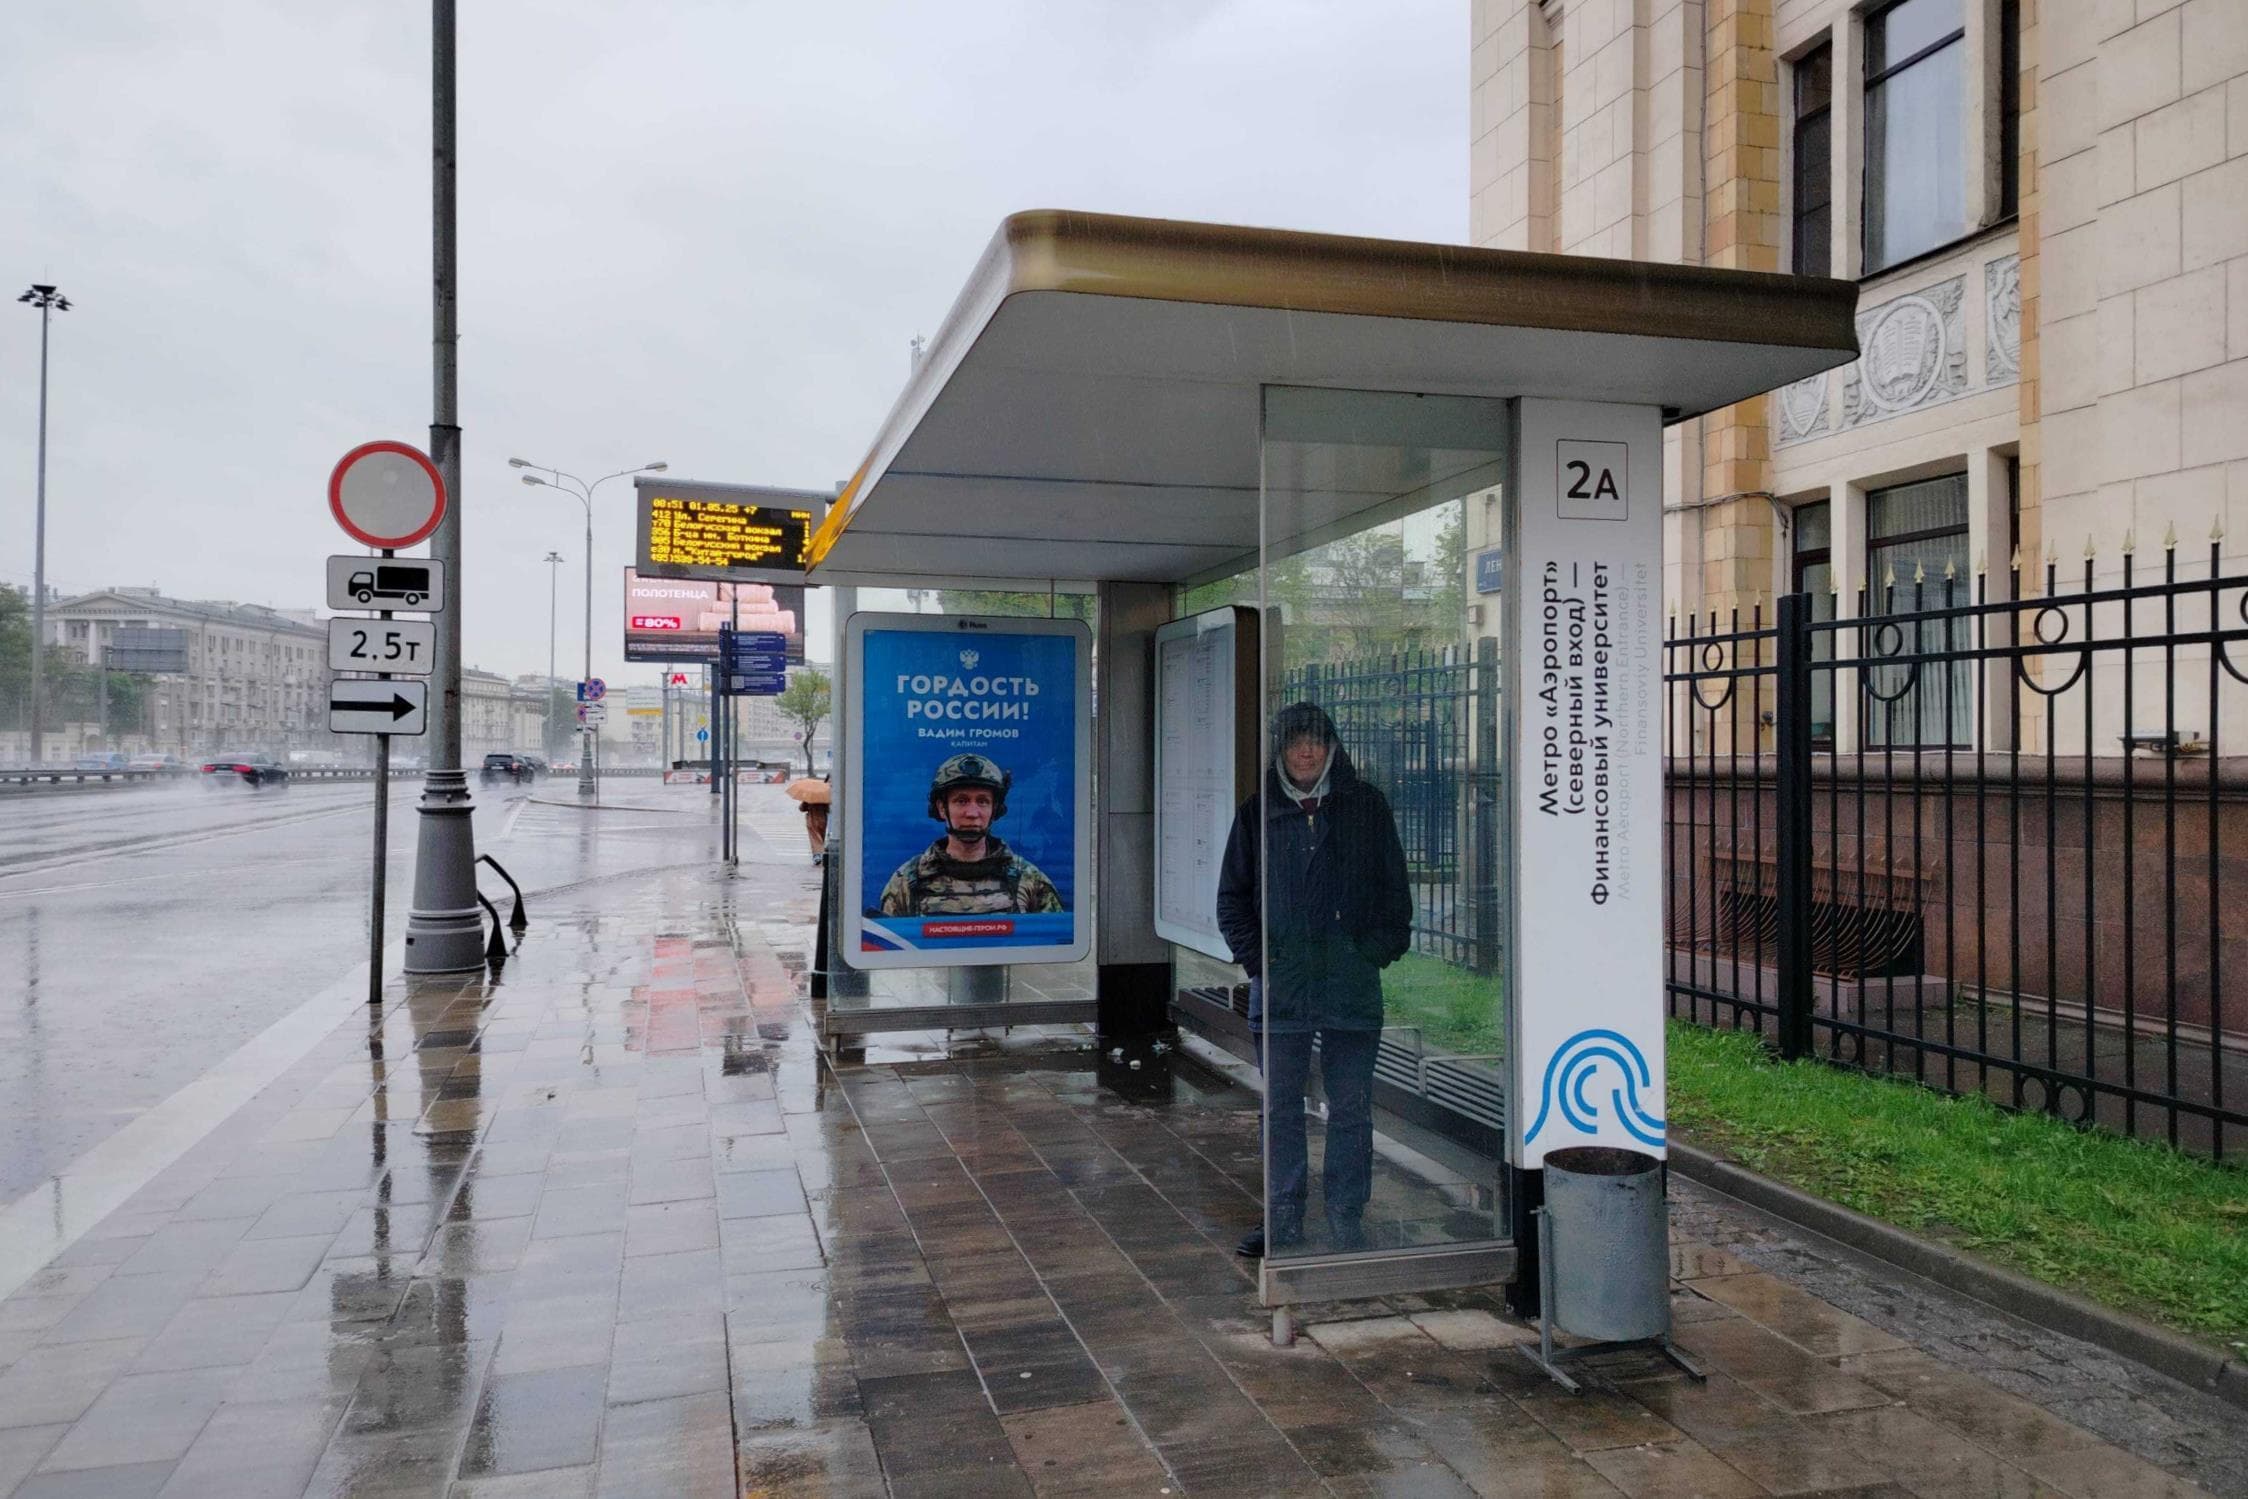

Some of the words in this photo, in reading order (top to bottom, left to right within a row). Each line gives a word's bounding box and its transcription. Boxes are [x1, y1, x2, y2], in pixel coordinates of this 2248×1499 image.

[652, 510, 671, 519] 412
[689, 501, 738, 513] 01.05.25
[745, 527, 782, 536] вокзал
[727, 532, 769, 543] Боткина
[745, 544, 781, 552] вокзал
[632, 588, 709, 599] ПОЛОТЕНЦА
[1634, 562, 1649, 659] Universitet
[1538, 560, 1563, 718] «Аэропорт»
[1562, 596, 1587, 668] вход)
[1592, 561, 1613, 728] университет
[1614, 586, 1631, 668] Entrance)
[897, 675, 1040, 697] ГОРДОСТЬ
[907, 700, 1030, 721] РОССИИ!
[1634, 664, 1651, 756] Finansoviy
[918, 727, 966, 739] ВАДИМ
[969, 728, 1020, 739] ГРОМОВ
[1614, 673, 1631, 759] (Northern
[950, 740, 988, 748] КАПИТАН
[1538, 725, 1563, 817] Метро
[1563, 676, 1588, 815] (северный
[1590, 736, 1611, 906] Финансовый
[1616, 846, 1631, 901] Metro
